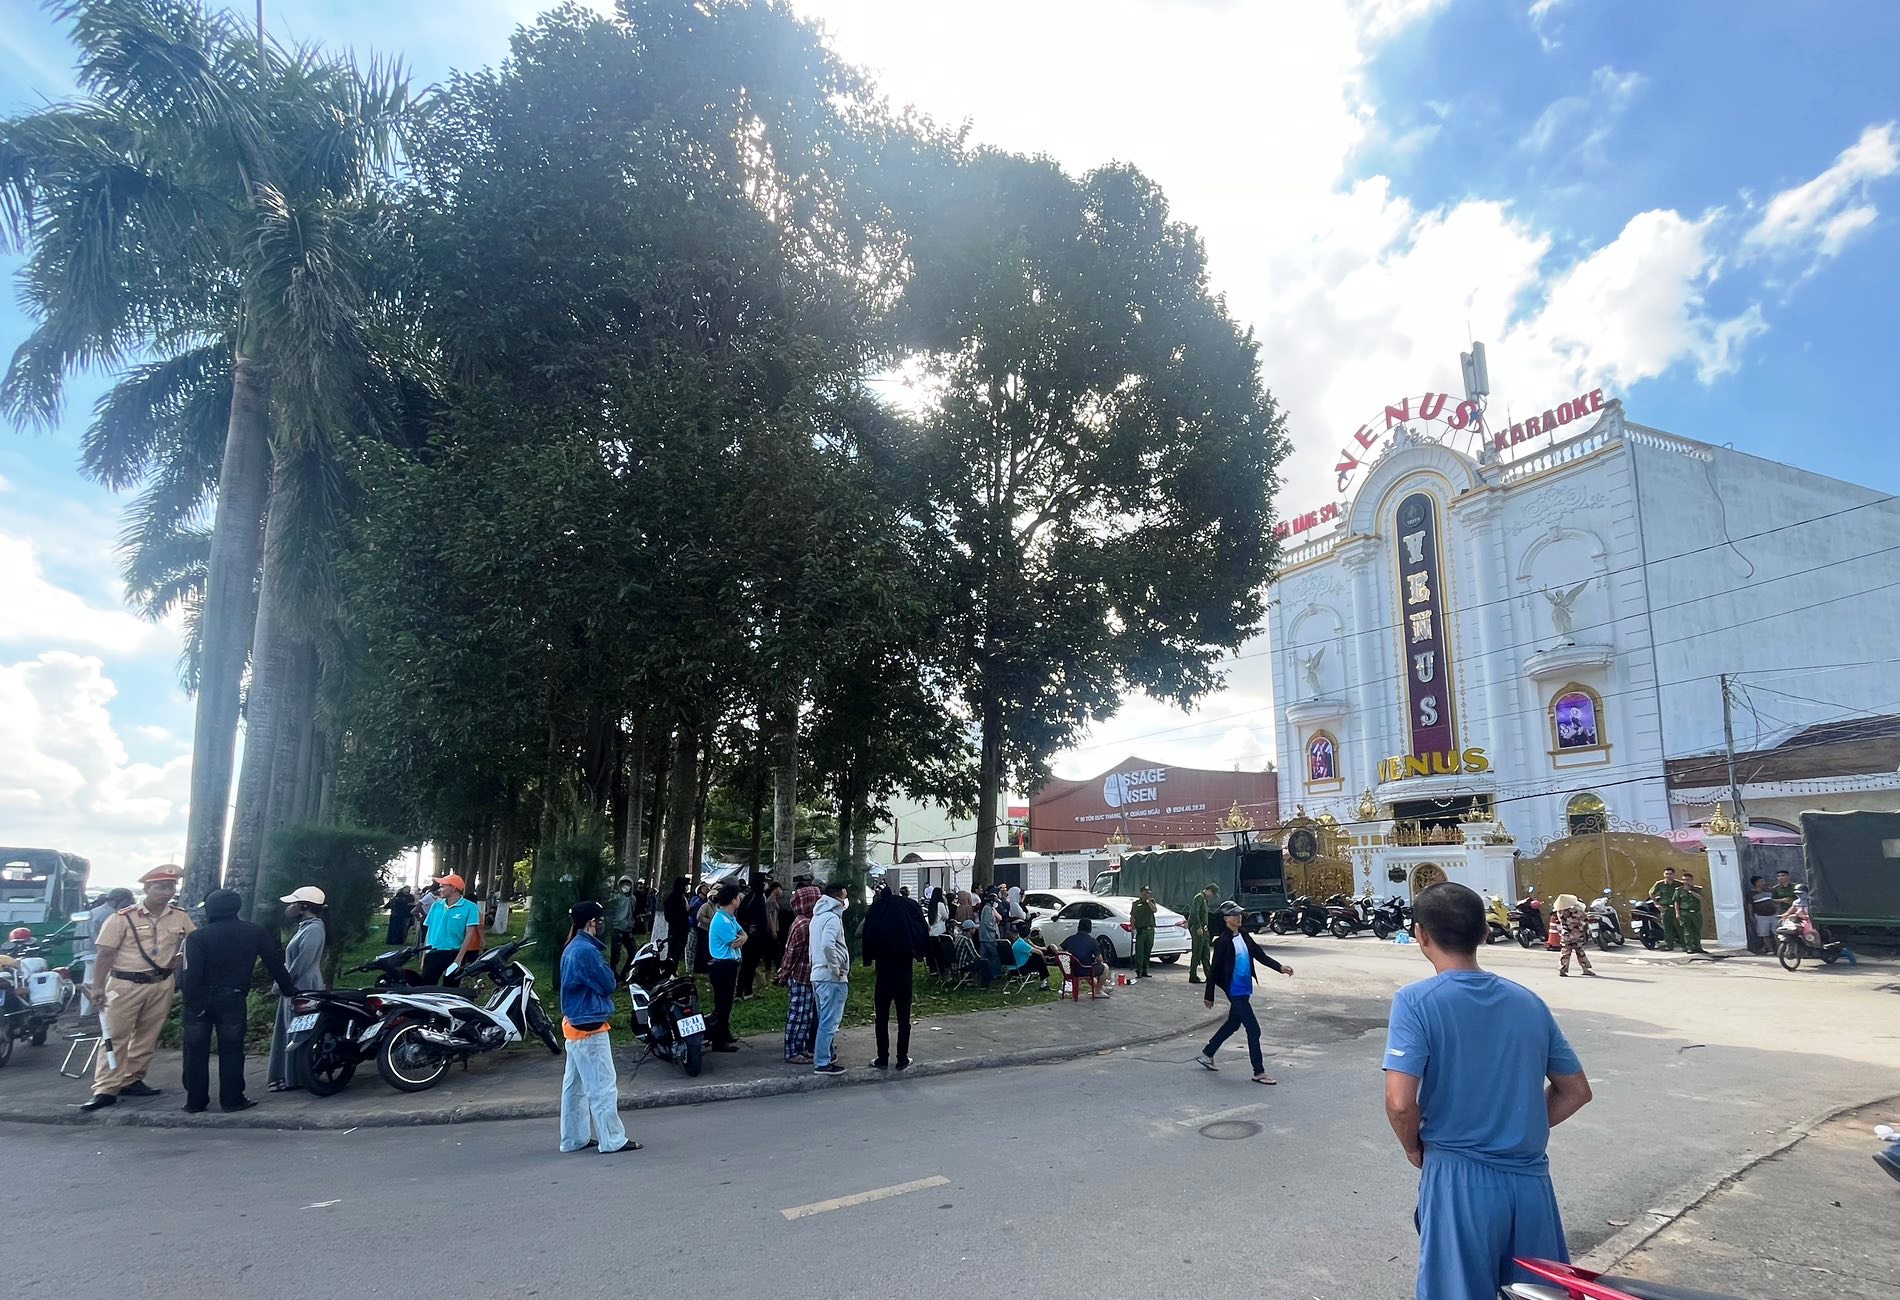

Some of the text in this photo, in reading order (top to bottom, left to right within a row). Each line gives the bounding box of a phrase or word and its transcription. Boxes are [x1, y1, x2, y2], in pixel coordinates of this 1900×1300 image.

[1335, 392, 1479, 472] VENUS
[1494, 388, 1605, 452] KARAOKE
[1320, 502, 1340, 524] SPA
[1403, 530, 1438, 726] VENUS
[1122, 768, 1167, 786] SSAGE
[1377, 747, 1489, 783] VENUS
[1122, 787, 1158, 804] NSEN
